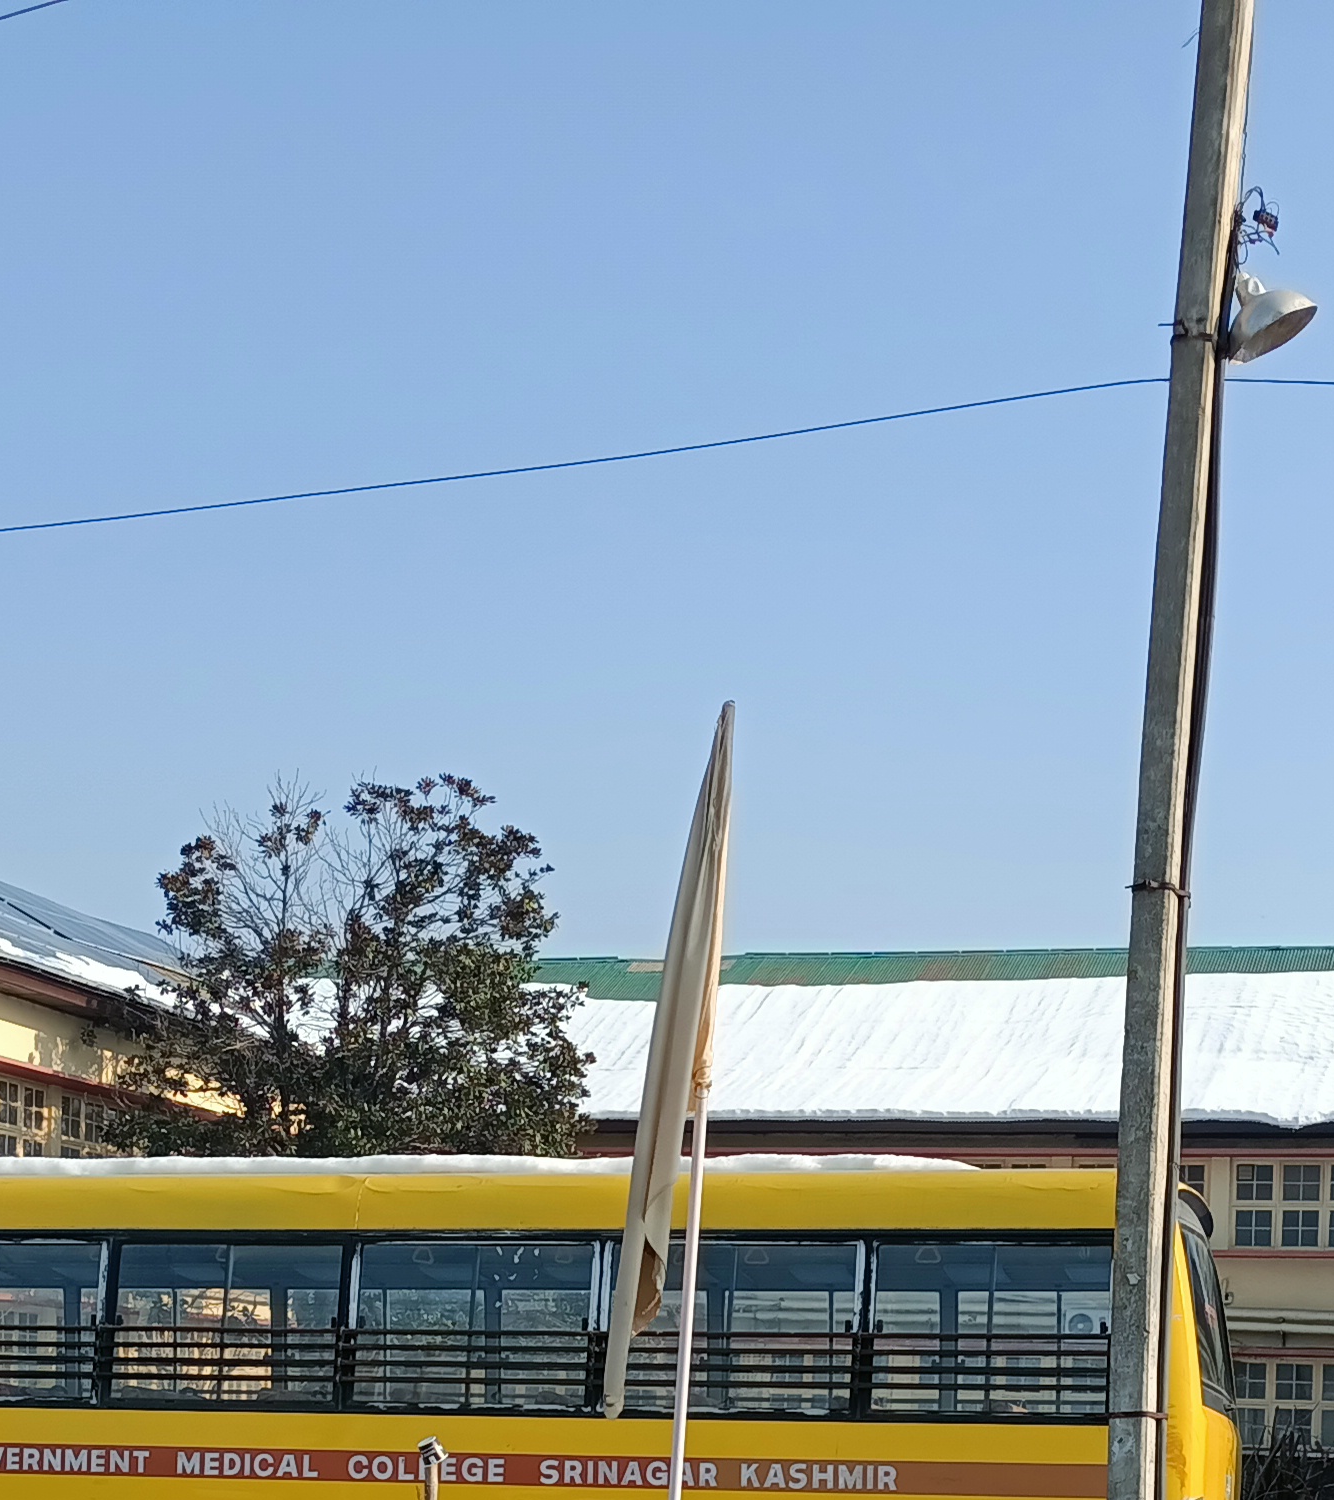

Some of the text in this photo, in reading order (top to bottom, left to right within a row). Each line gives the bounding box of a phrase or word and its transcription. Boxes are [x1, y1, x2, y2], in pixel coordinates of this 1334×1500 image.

[176, 1451, 319, 1478] MEDICAL
[348, 1454, 505, 1482] COLLEGE
[539, 1459, 717, 1487] SRINAGAR
[740, 1463, 897, 1491] KASHMIR
